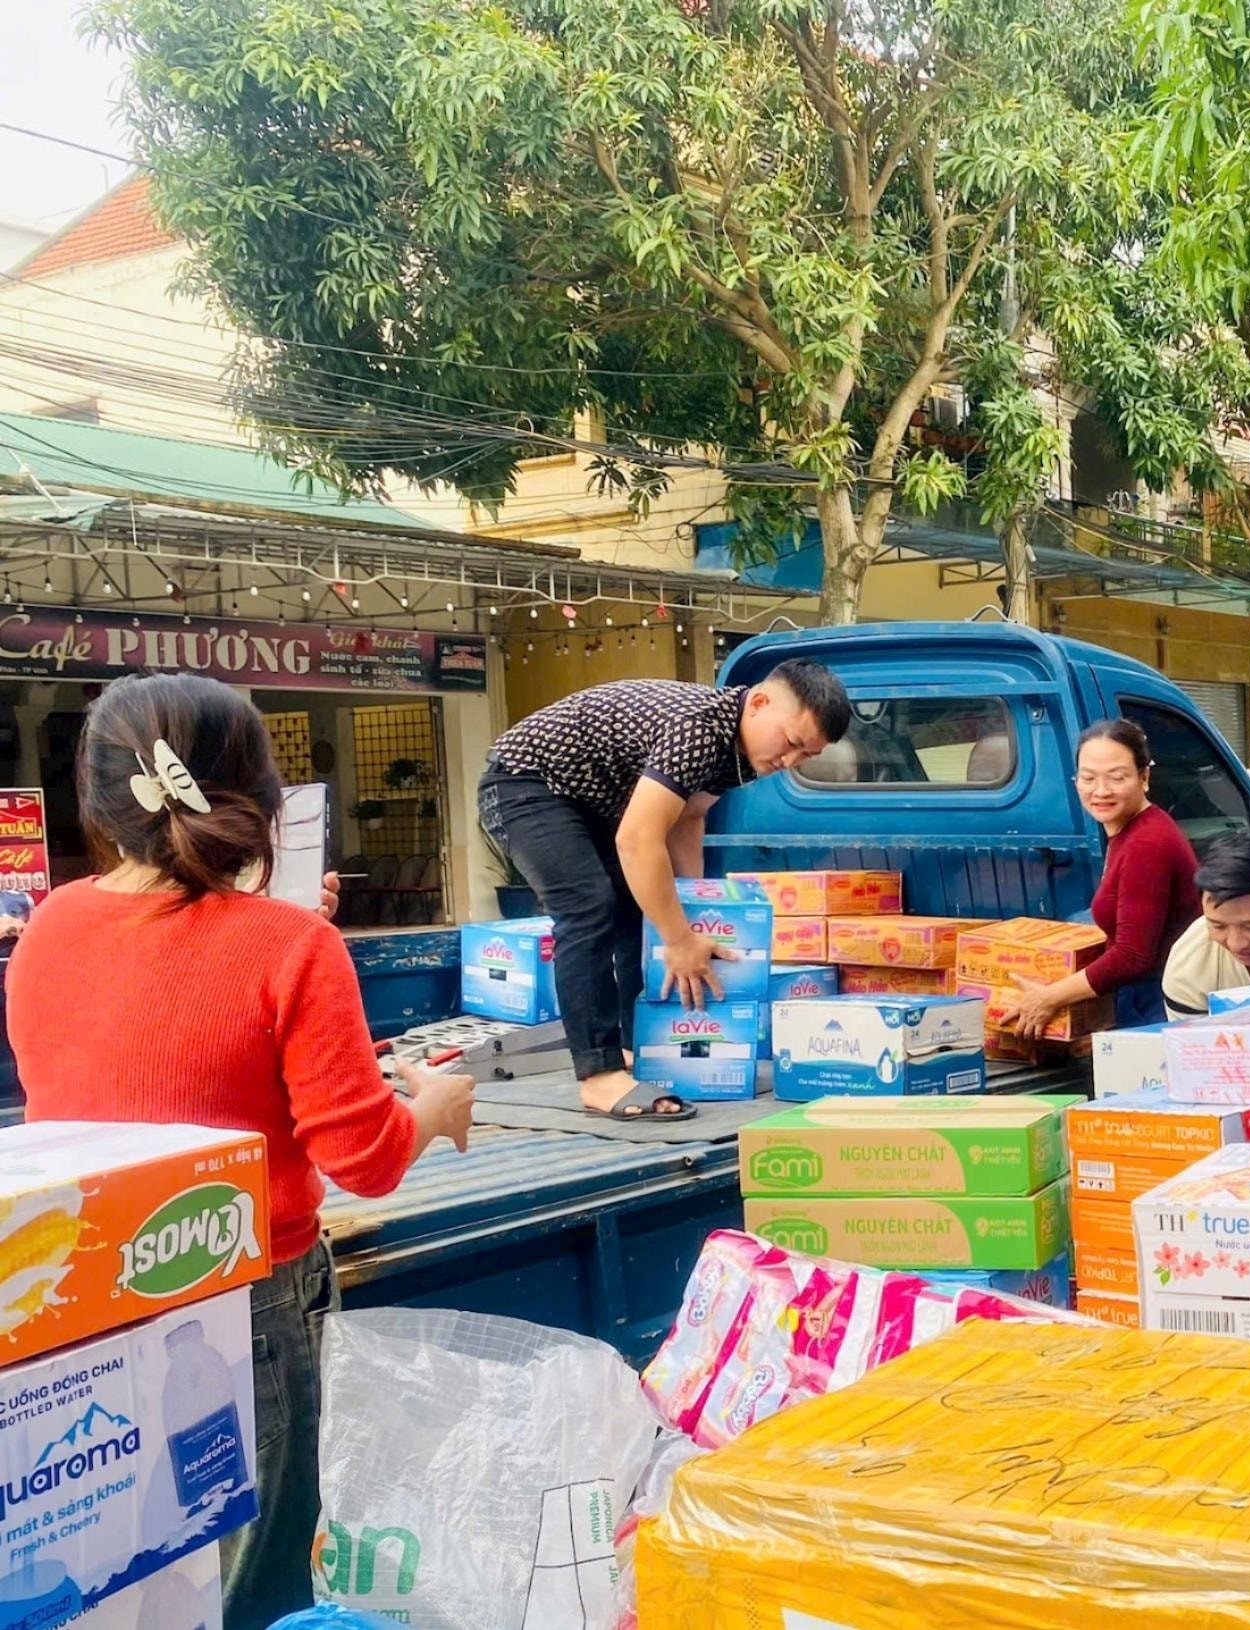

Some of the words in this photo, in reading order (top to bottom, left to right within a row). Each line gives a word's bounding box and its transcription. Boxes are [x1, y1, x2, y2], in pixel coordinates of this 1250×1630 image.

[0, 614, 93, 671] Café
[104, 627, 311, 675] PHƯƠNG
[320, 651, 352, 661] Nước
[356, 654, 382, 664] cam,
[386, 655, 421, 665] chanh
[320, 665, 346, 674] sinh
[350, 663, 362, 675] tố
[395, 667, 422, 677] chua
[690, 919, 735, 936] aVie
[482, 943, 513, 961] laVie
[790, 980, 819, 996] laVie
[672, 1018, 721, 1035] laVie
[807, 1035, 863, 1058] AQUAFINA
[1175, 1126, 1214, 1140] TOPKID
[839, 1144, 902, 1161] NGUYÊN
[907, 1141, 947, 1161] CHẤT
[194, 1162, 207, 1176] ml
[208, 1156, 226, 1171] 170
[753, 1151, 819, 1178] Fami
[844, 1217, 907, 1235] NGUYÊN
[912, 1214, 953, 1234] CHẤT
[1153, 1213, 1185, 1232] TH
[1202, 1212, 1250, 1235] true
[1215, 1238, 1241, 1250] Nước
[8, 1384, 49, 1413] UỐNG
[91, 1357, 125, 1379] CHAI
[0, 1401, 53, 1430] BOTTLED
[56, 1384, 94, 1408] WATER
[183, 1436, 236, 1475] Aquaroma
[6, 1514, 40, 1544] mát
[42, 1508, 54, 1527] &
[96, 1474, 137, 1503] khoái
[589, 1491, 601, 1545] PREMIUM
[602, 1488, 614, 1544] JAPONICA
[10, 1531, 46, 1561] Fresh
[48, 1527, 58, 1544] &
